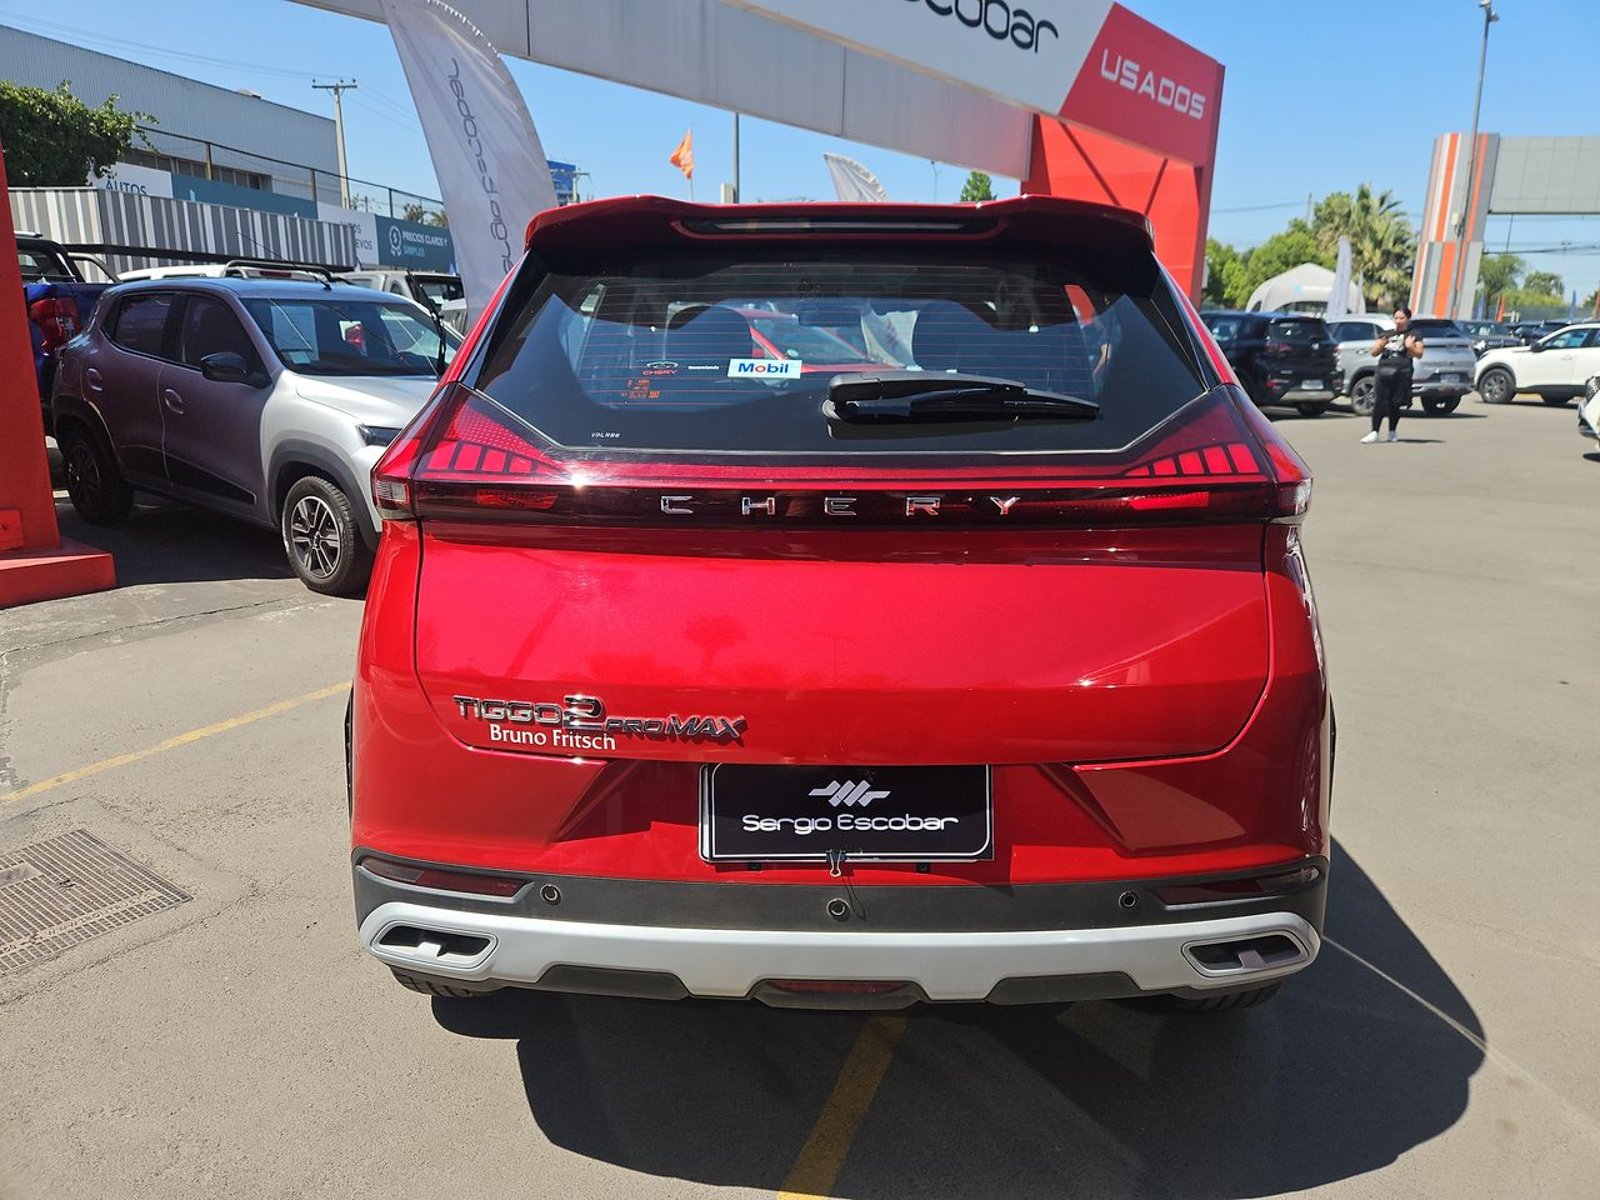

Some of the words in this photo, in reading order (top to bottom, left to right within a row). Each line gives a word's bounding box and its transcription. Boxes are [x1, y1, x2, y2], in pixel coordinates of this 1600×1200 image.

[1100, 48, 1207, 120] USADOS
[354, 239, 373, 250] EVOS
[738, 363, 789, 373] Mobil
[660, 495, 1020, 516] CHERY
[453, 695, 562, 724] TIGGO
[563, 694, 604, 730] 2
[490, 724, 547, 746] Bruno
[553, 729, 616, 750] Fritsch
[742, 813, 832, 835] Sergio
[837, 813, 959, 831] Escobar
